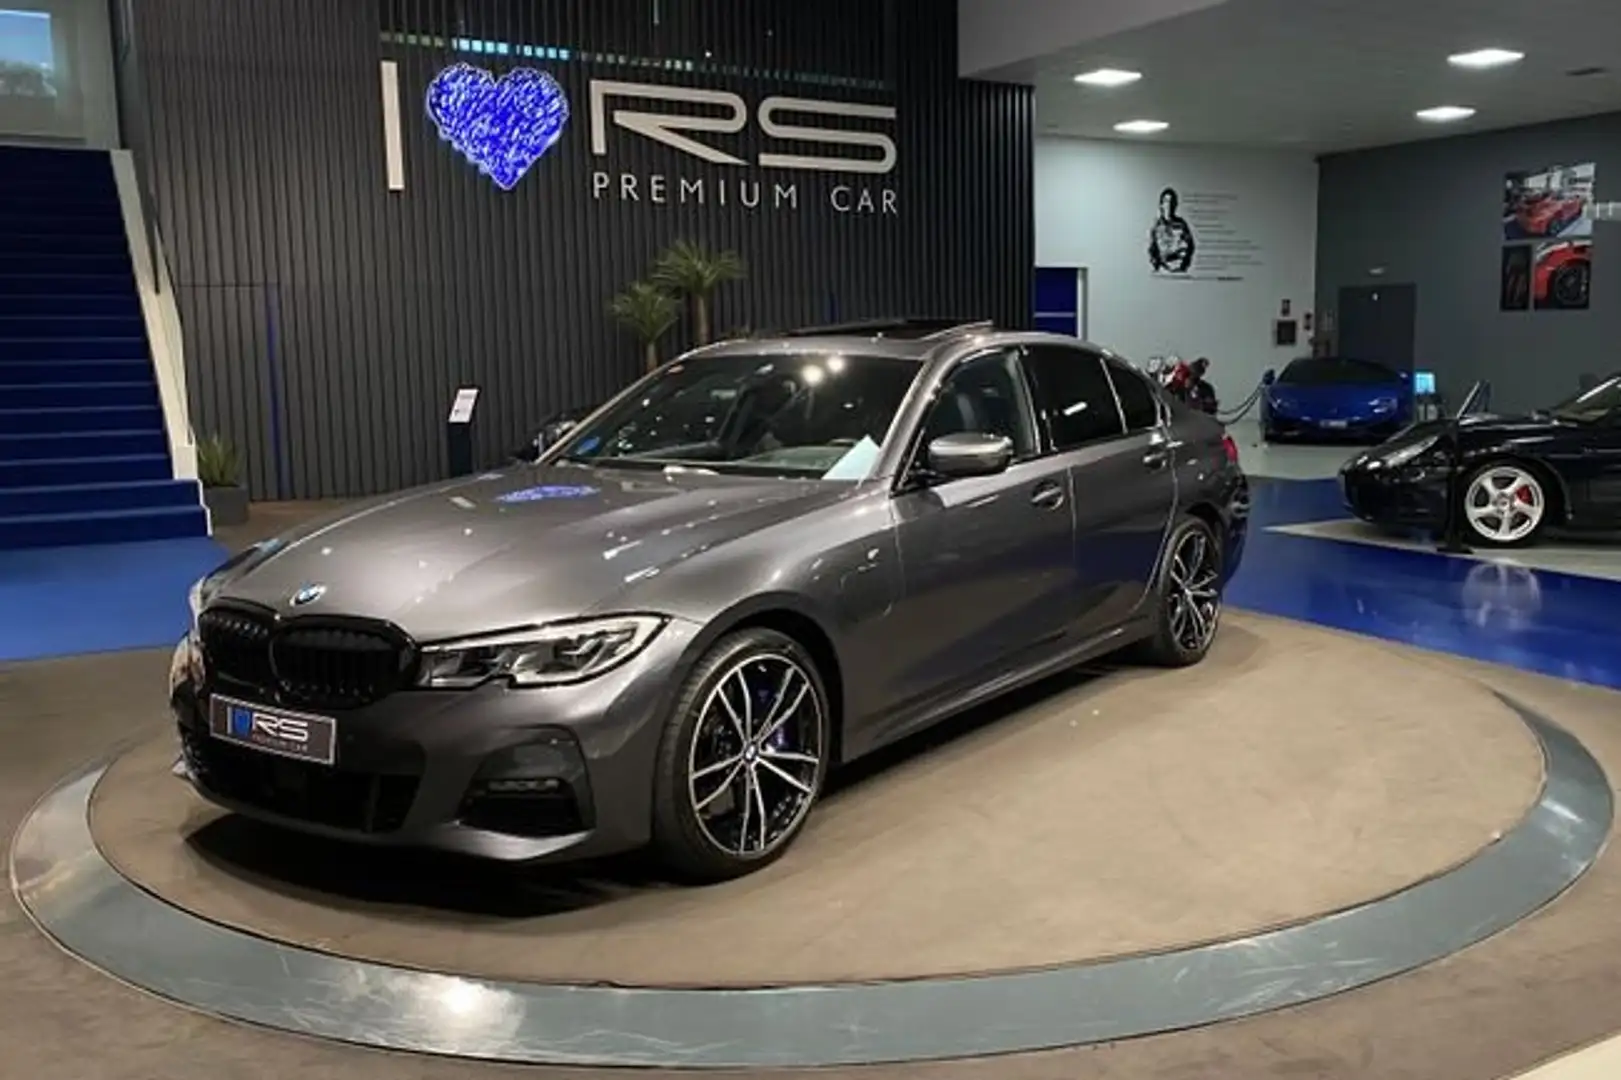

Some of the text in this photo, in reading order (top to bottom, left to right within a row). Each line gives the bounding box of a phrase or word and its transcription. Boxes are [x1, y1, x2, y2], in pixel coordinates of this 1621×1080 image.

[590, 79, 897, 174] RS
[593, 171, 897, 214] PREMIUM CAR
[252, 712, 309, 742] RS
